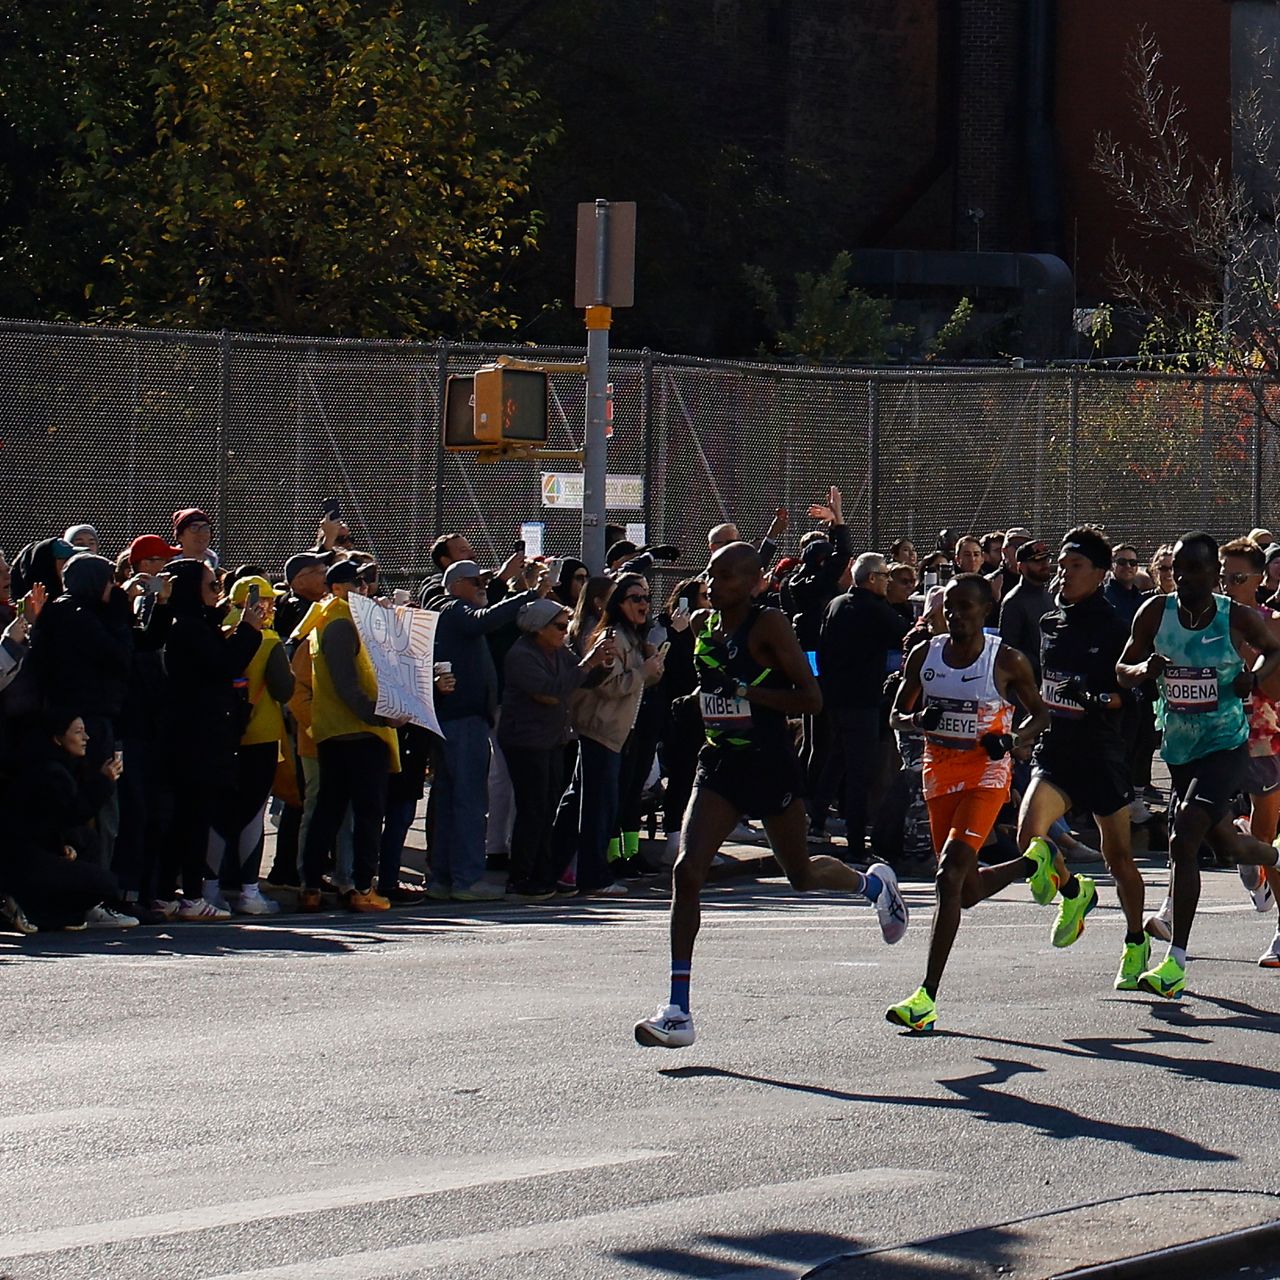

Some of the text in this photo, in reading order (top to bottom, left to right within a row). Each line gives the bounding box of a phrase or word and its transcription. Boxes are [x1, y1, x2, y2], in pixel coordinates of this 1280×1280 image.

[353, 598, 413, 652] YOU
[1166, 683, 1217, 699] GOBENA
[939, 718, 976, 734] GEEYE
